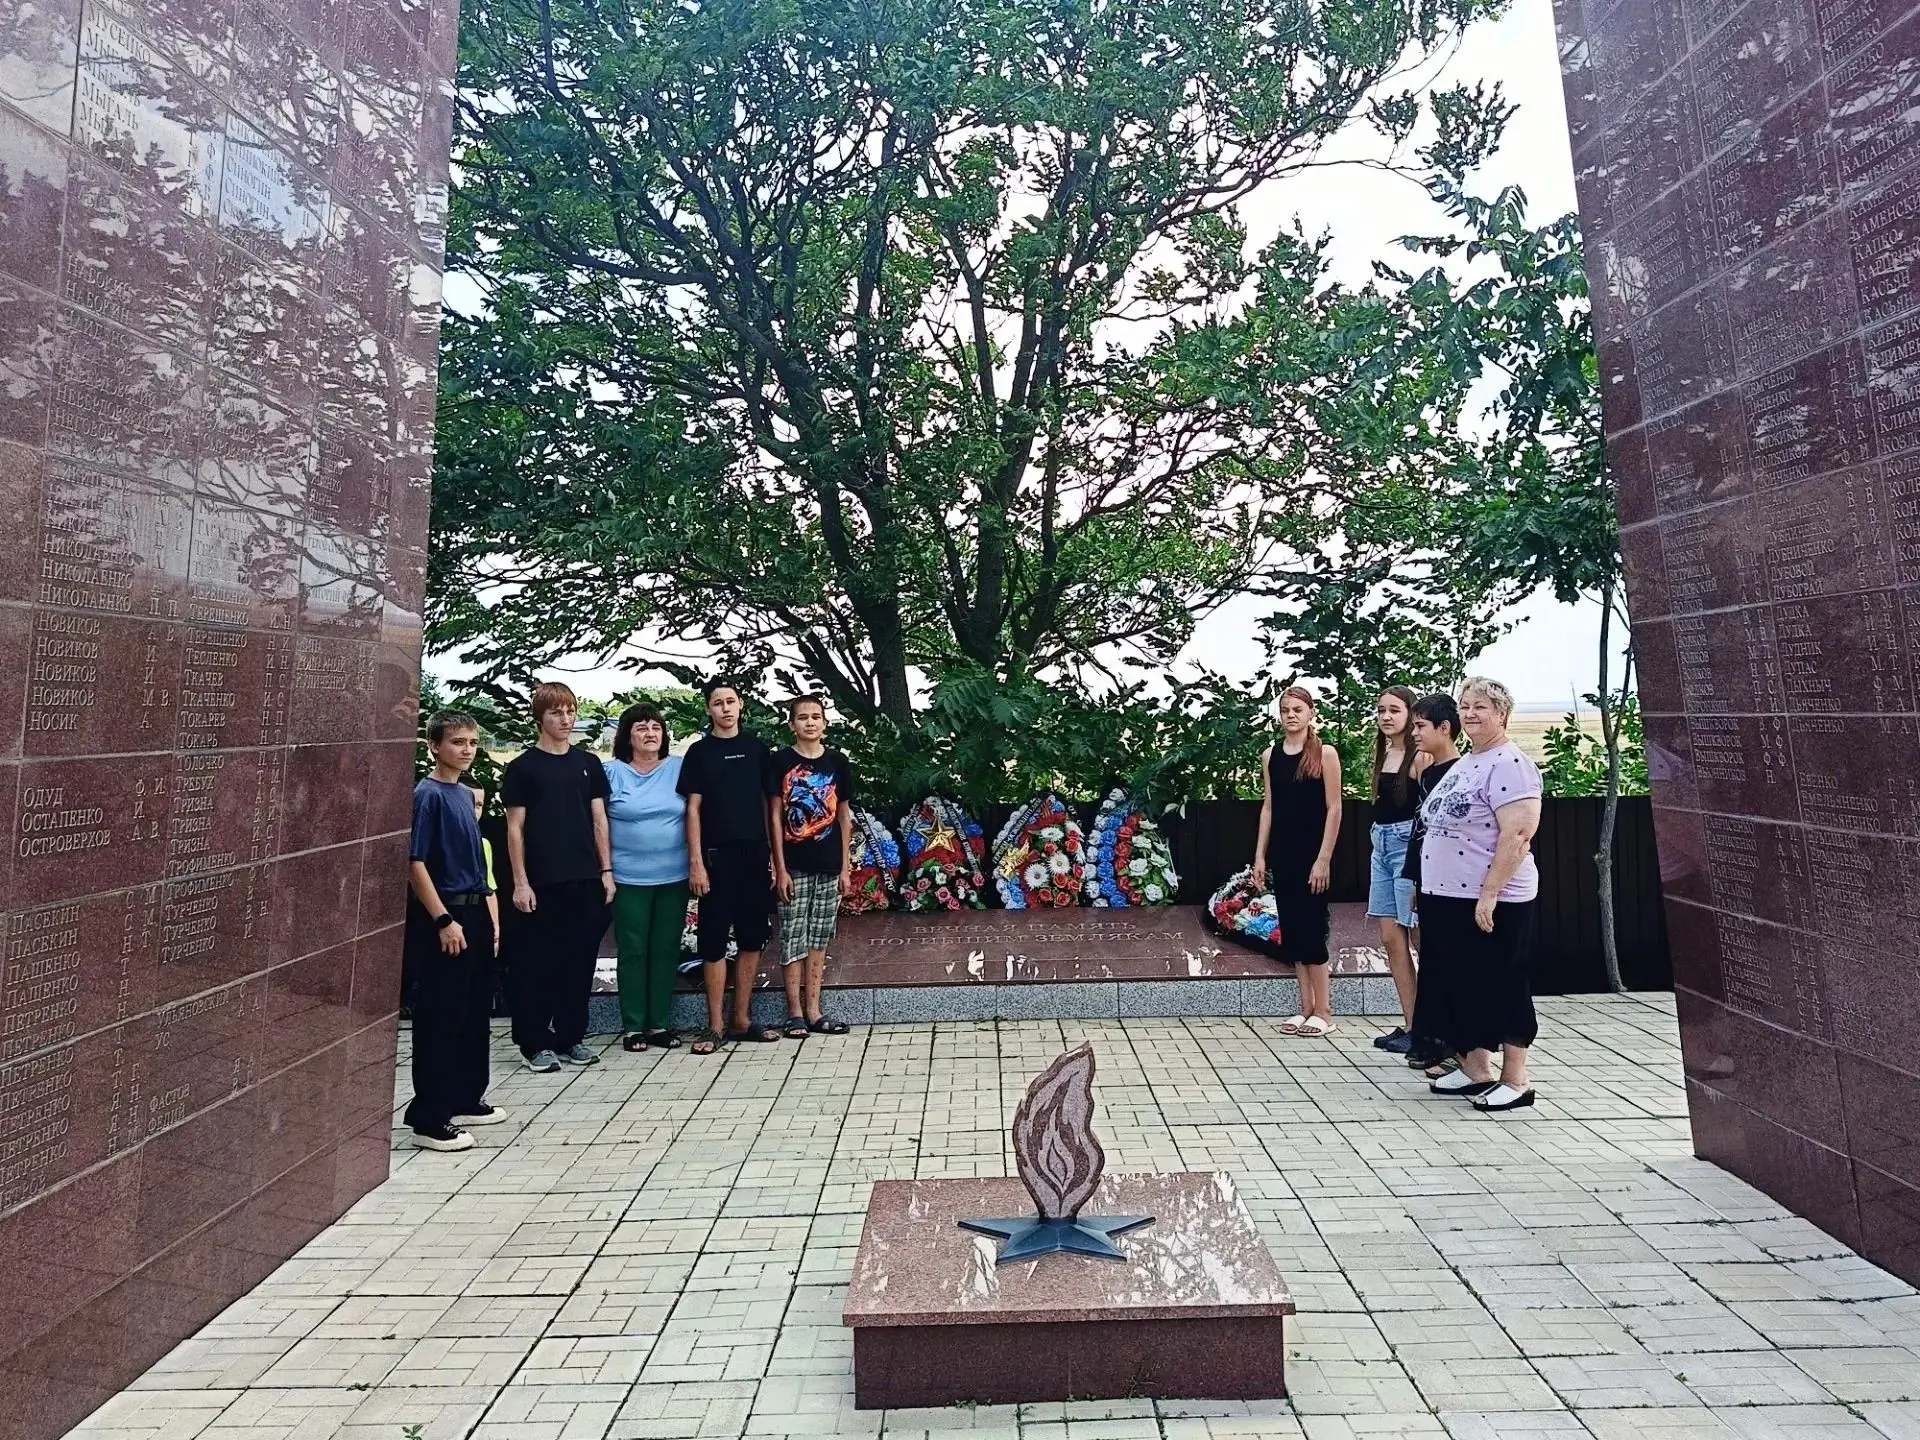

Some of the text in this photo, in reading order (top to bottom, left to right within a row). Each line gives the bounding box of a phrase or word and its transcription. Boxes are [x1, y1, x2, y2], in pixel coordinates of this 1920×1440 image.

[41, 558, 134, 590] НИКОЛАЕНКО
[39, 583, 132, 613] НИКОЛАЕНКО
[38, 611, 101, 635] НОВИКОВ
[36, 637, 98, 659] НОВИКОВ
[185, 648, 238, 667] ТЕСЛЕНКО
[34, 662, 97, 682] НОВИКОВ
[184, 669, 225, 686] ТКАЧЕВ
[31, 687, 94, 706] НОВИКОВ
[182, 689, 236, 707] ТКАЧЕНКО
[29, 711, 79, 731] НОСИК
[181, 711, 226, 728] ТОКАРЕВ
[179, 732, 218, 749] ТОКАРЬ
[176, 755, 225, 772] ТОЛОЧКО
[175, 775, 215, 792] ТРЕБУХ
[23, 788, 65, 809] ОДУД
[173, 796, 214, 814] ТРИЗНА
[21, 807, 104, 833] ОСТАПЕНКО
[172, 816, 212, 834] ТРИЗНА
[19, 829, 112, 858] ОСТРОВЕРХОВ
[170, 837, 211, 855] ТРИЗНА
[165, 896, 218, 921] ТУРЧЕНКО
[10, 905, 81, 936] ПАСЕКИН
[163, 915, 217, 943] ТУРЧЕНКО
[912, 921, 1138, 934] ВЕЧНАЯ ПАМЯТЬ
[9, 928, 79, 961] ПАСЕКИН
[868, 931, 1186, 947] ПОГИБШИМ ЗЕМЛЯКАМ
[161, 935, 216, 964] ТУРЧЕНКО
[2, 998, 77, 1036] ПЕТРЕНКО
